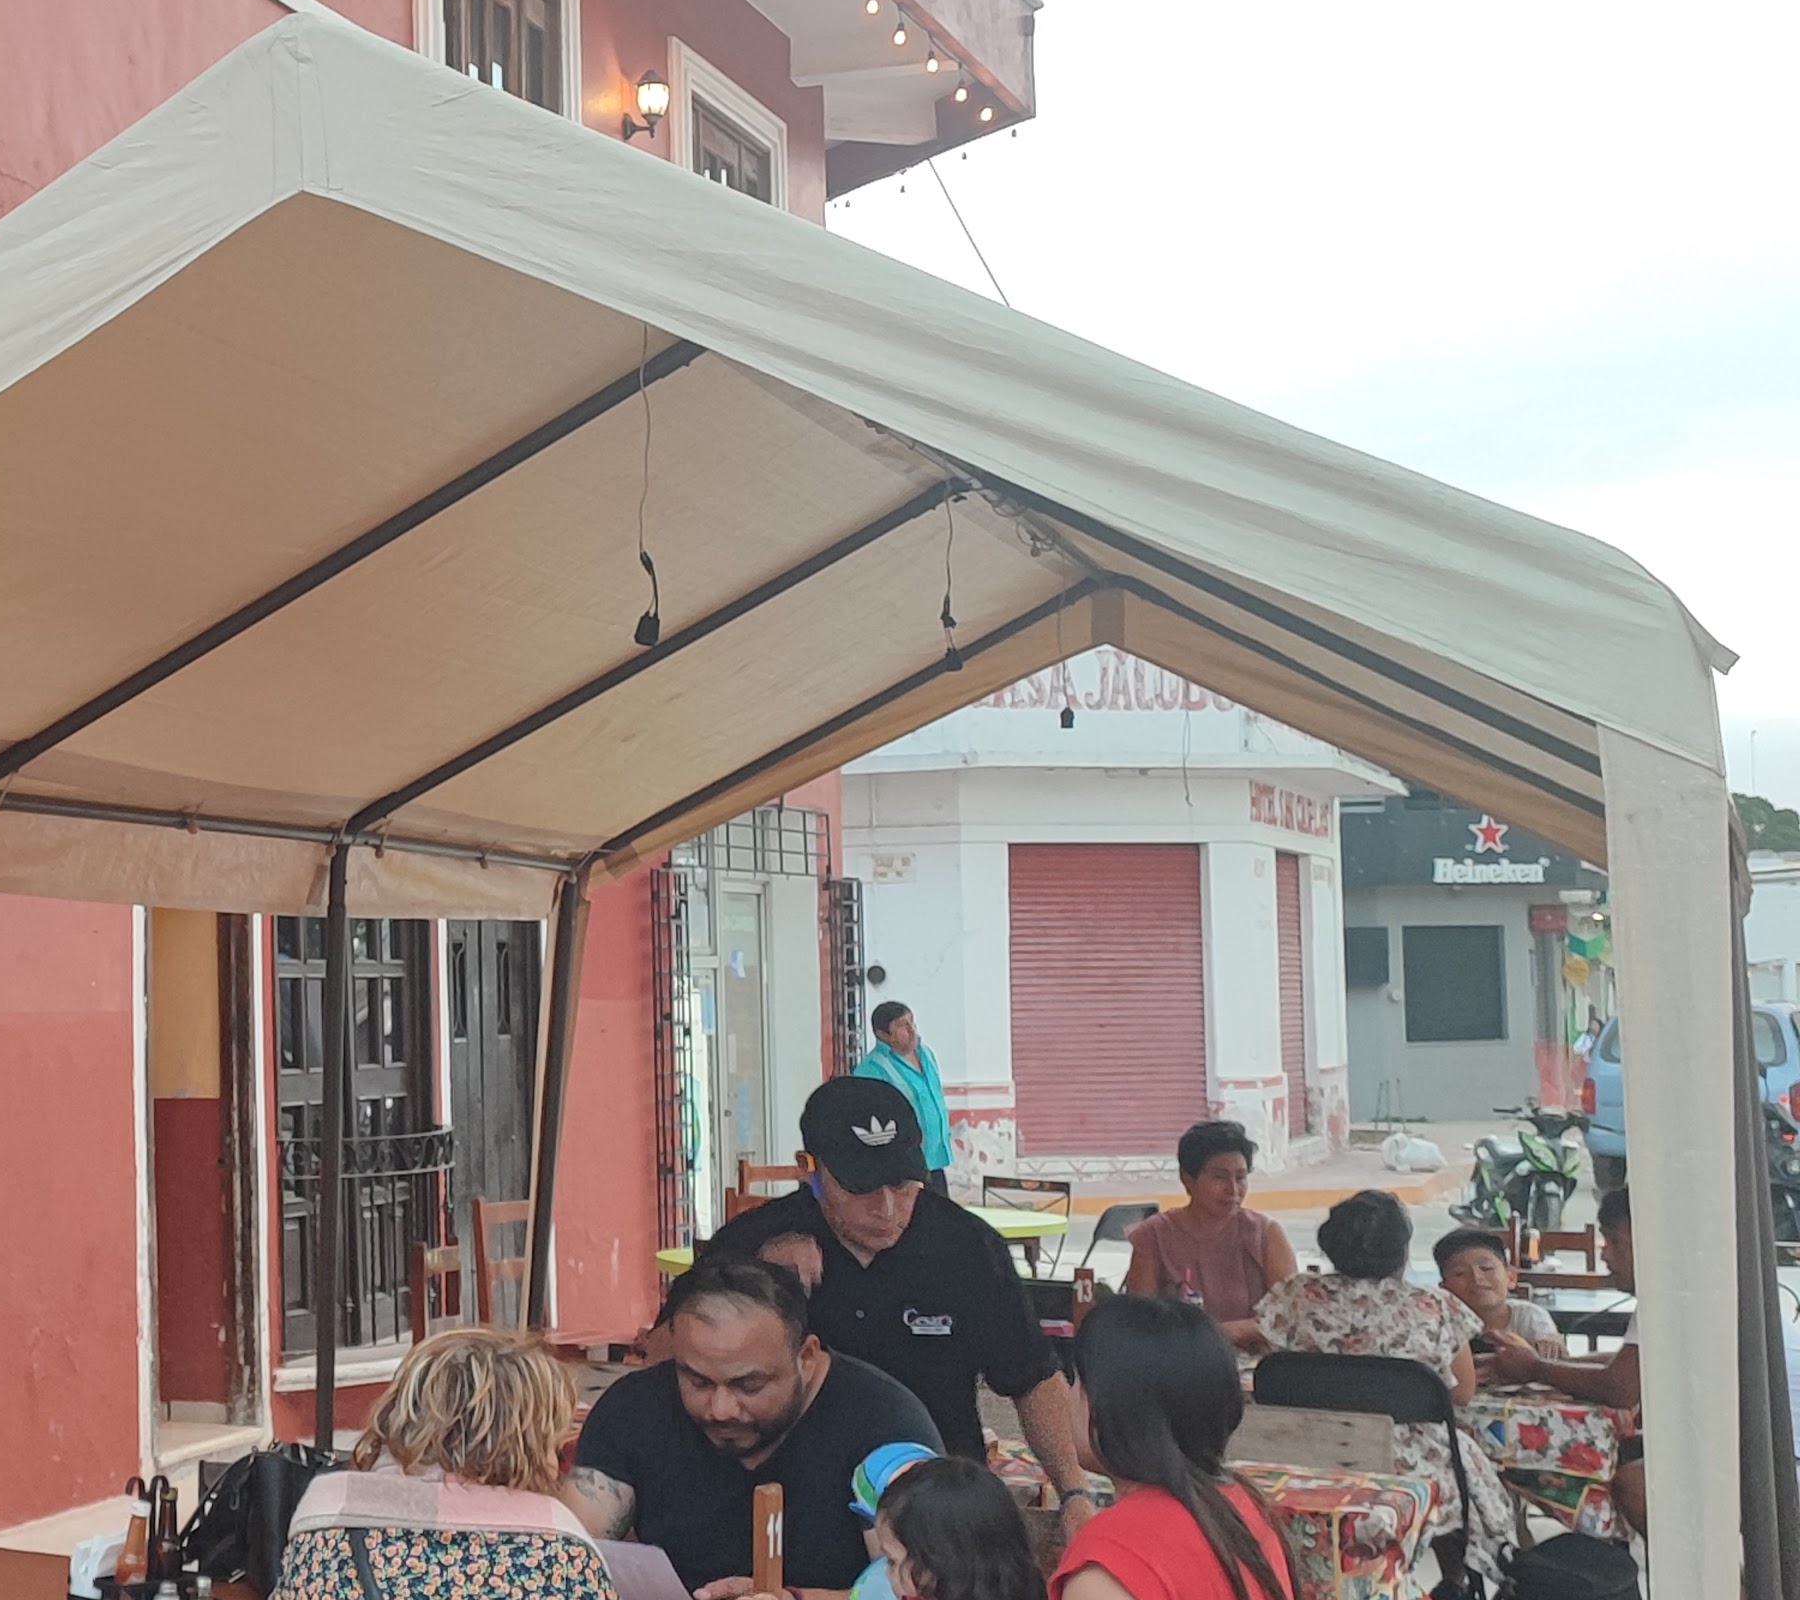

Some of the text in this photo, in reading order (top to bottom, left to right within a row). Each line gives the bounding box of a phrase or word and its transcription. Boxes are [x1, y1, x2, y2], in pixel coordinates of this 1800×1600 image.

[1433, 857, 1545, 883] Heineken
[1073, 1279, 1093, 1304] 13
[767, 1511, 783, 1559] 11
